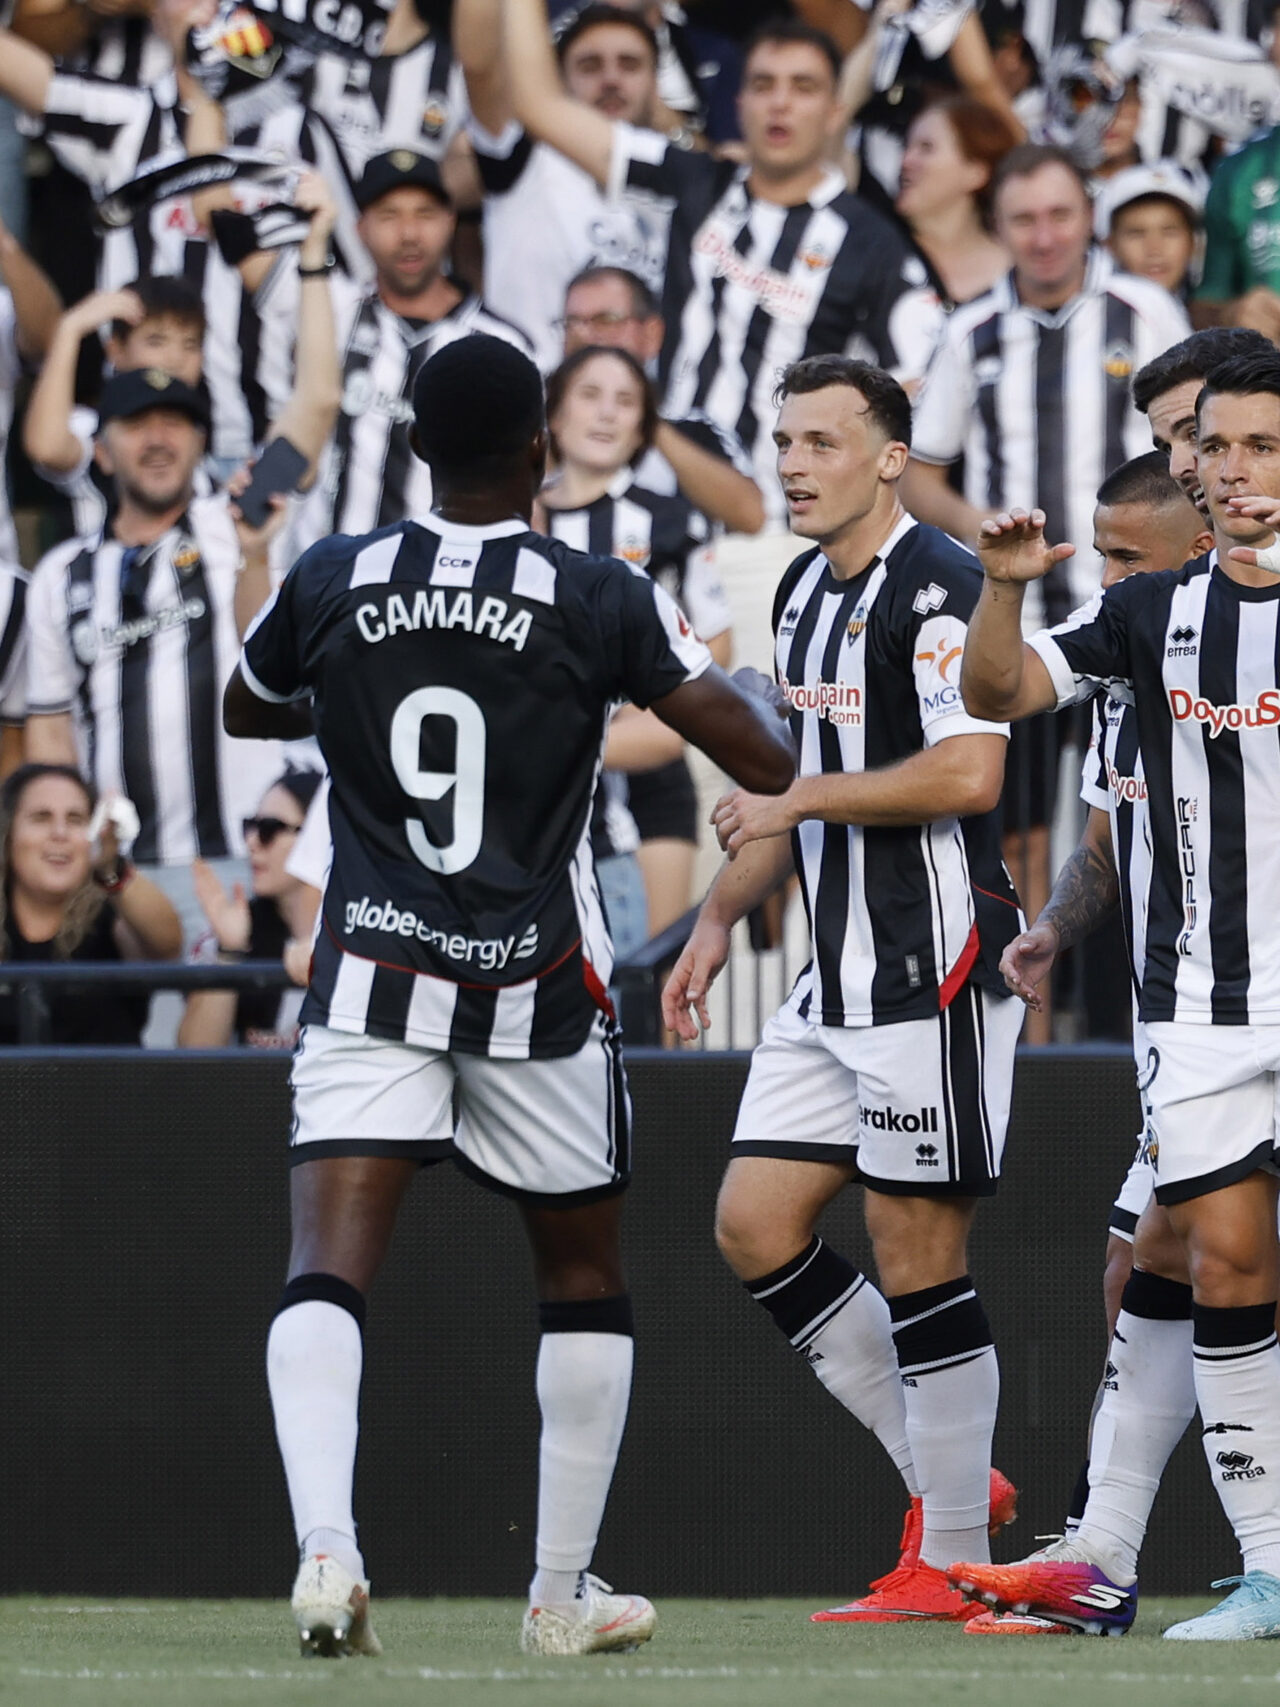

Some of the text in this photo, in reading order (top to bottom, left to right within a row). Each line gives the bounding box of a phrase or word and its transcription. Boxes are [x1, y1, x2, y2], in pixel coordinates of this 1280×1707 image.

[355, 590, 534, 652] CAMARA
[1167, 645, 1197, 658] errea
[390, 685, 486, 876] 9
[1177, 797, 1197, 956] REPCAR
[915, 1158, 939, 1168] errea
[1221, 1465, 1267, 1482] errea
